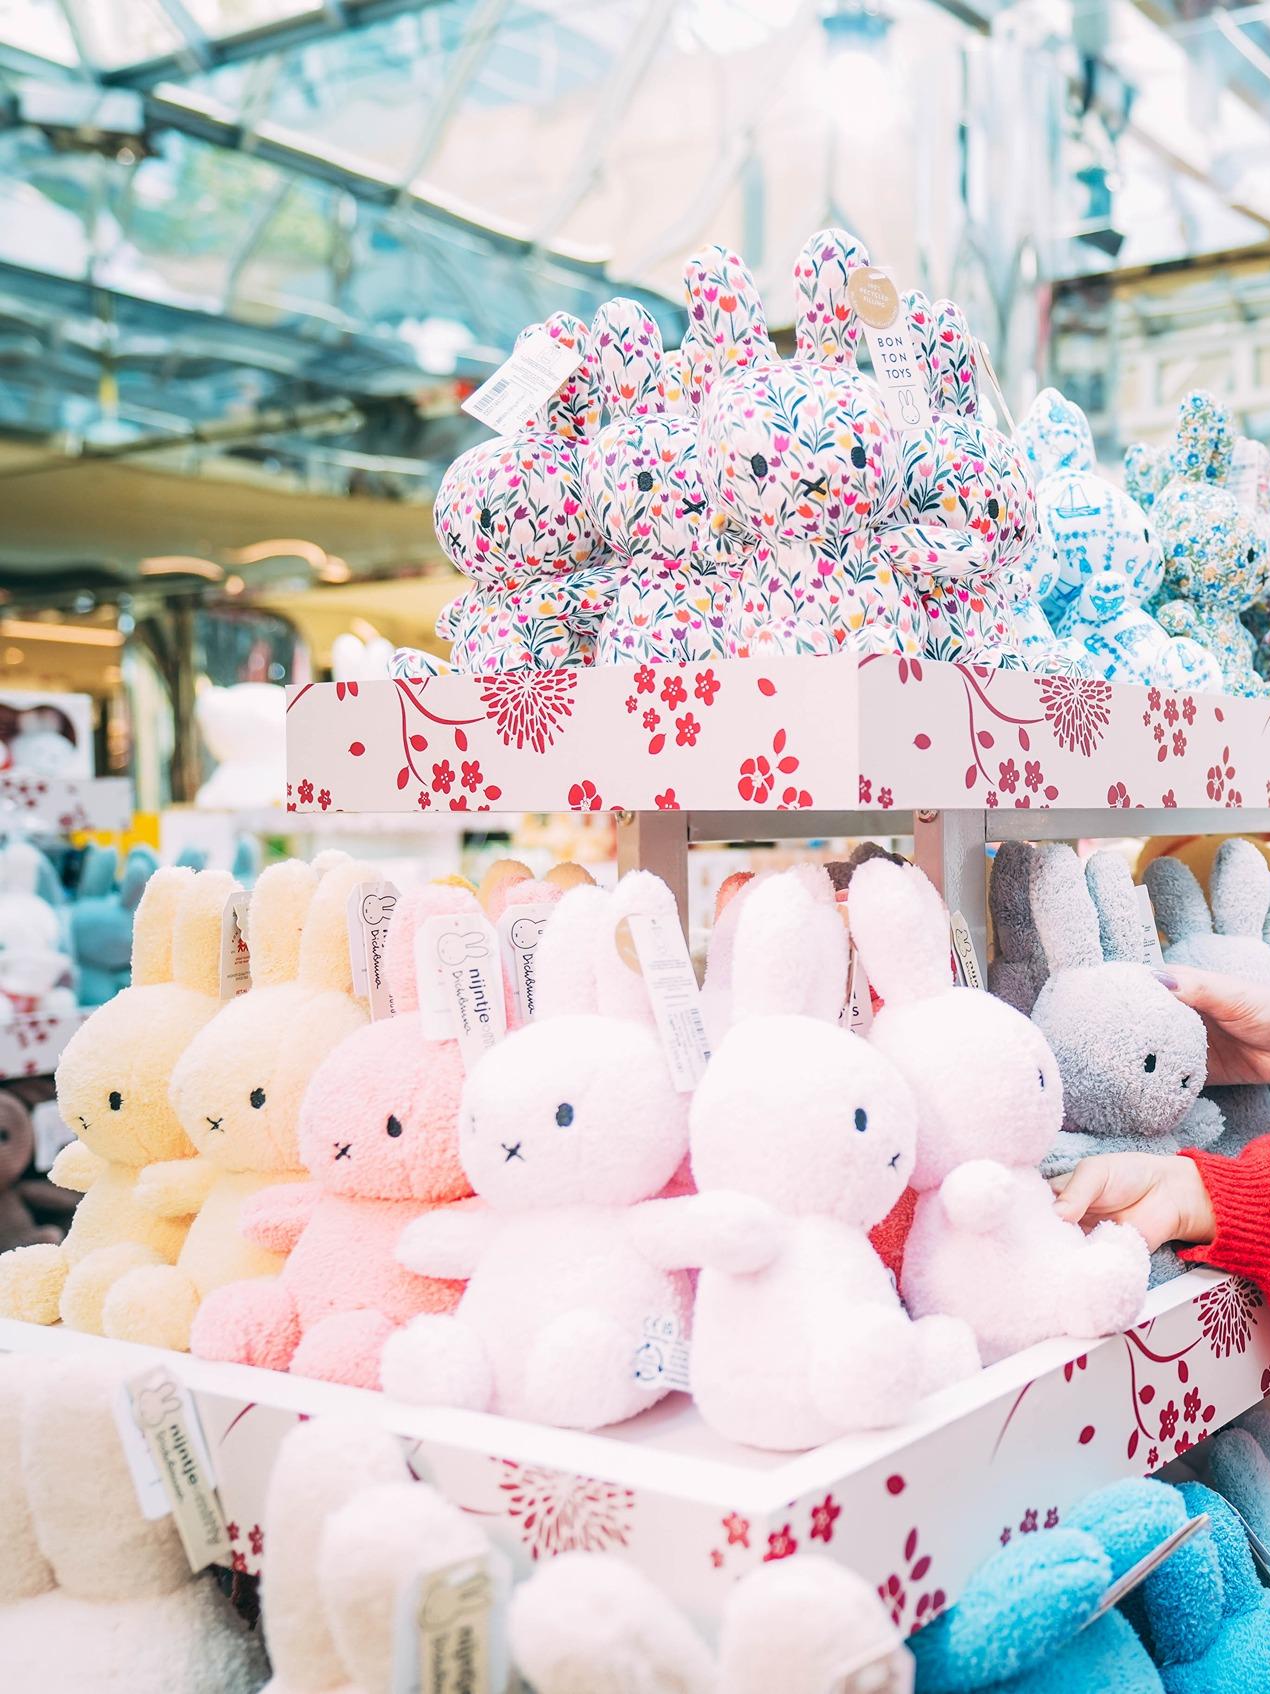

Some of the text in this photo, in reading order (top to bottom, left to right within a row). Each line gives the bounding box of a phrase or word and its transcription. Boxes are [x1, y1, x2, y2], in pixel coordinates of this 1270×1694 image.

[877, 336, 904, 348] BON
[881, 352, 908, 363] TON
[886, 368, 912, 379] TOYS
[468, 968, 491, 1024] nijntje
